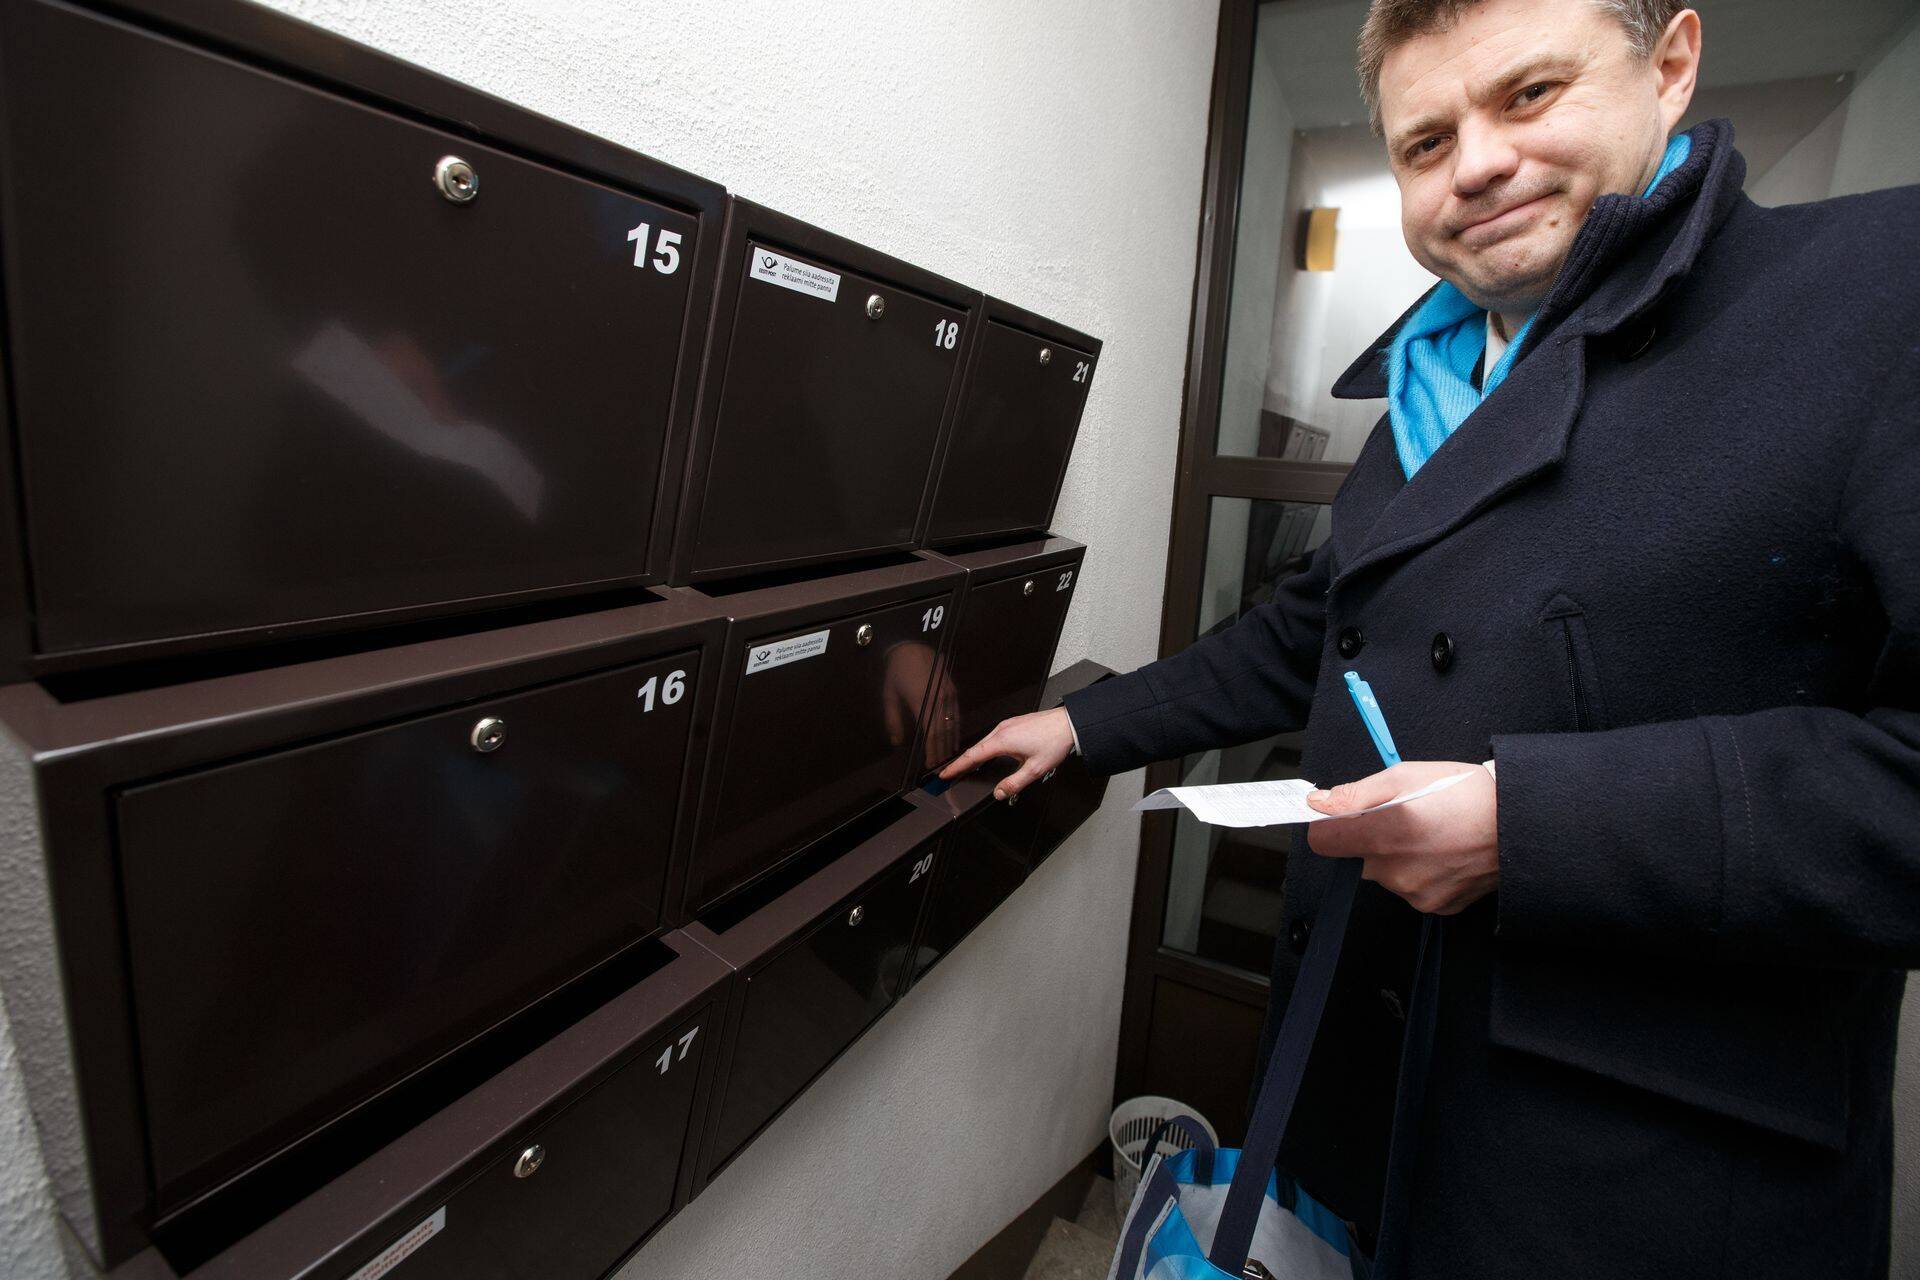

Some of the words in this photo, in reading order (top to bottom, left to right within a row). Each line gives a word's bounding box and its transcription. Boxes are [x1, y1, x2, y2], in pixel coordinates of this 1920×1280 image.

[627, 222, 682, 275] 15
[781, 272, 804, 285] reklaami
[803, 279, 817, 289] mitte
[816, 284, 832, 293] panna
[783, 262, 802, 275] Palume
[811, 273, 835, 285] aadressita
[935, 319, 959, 350] 18
[1072, 361, 1090, 384] 21
[1056, 570, 1073, 593] 22
[922, 605, 945, 632] 19
[637, 669, 686, 713] 16
[908, 853, 934, 885] 20
[655, 1026, 699, 1075] 17
